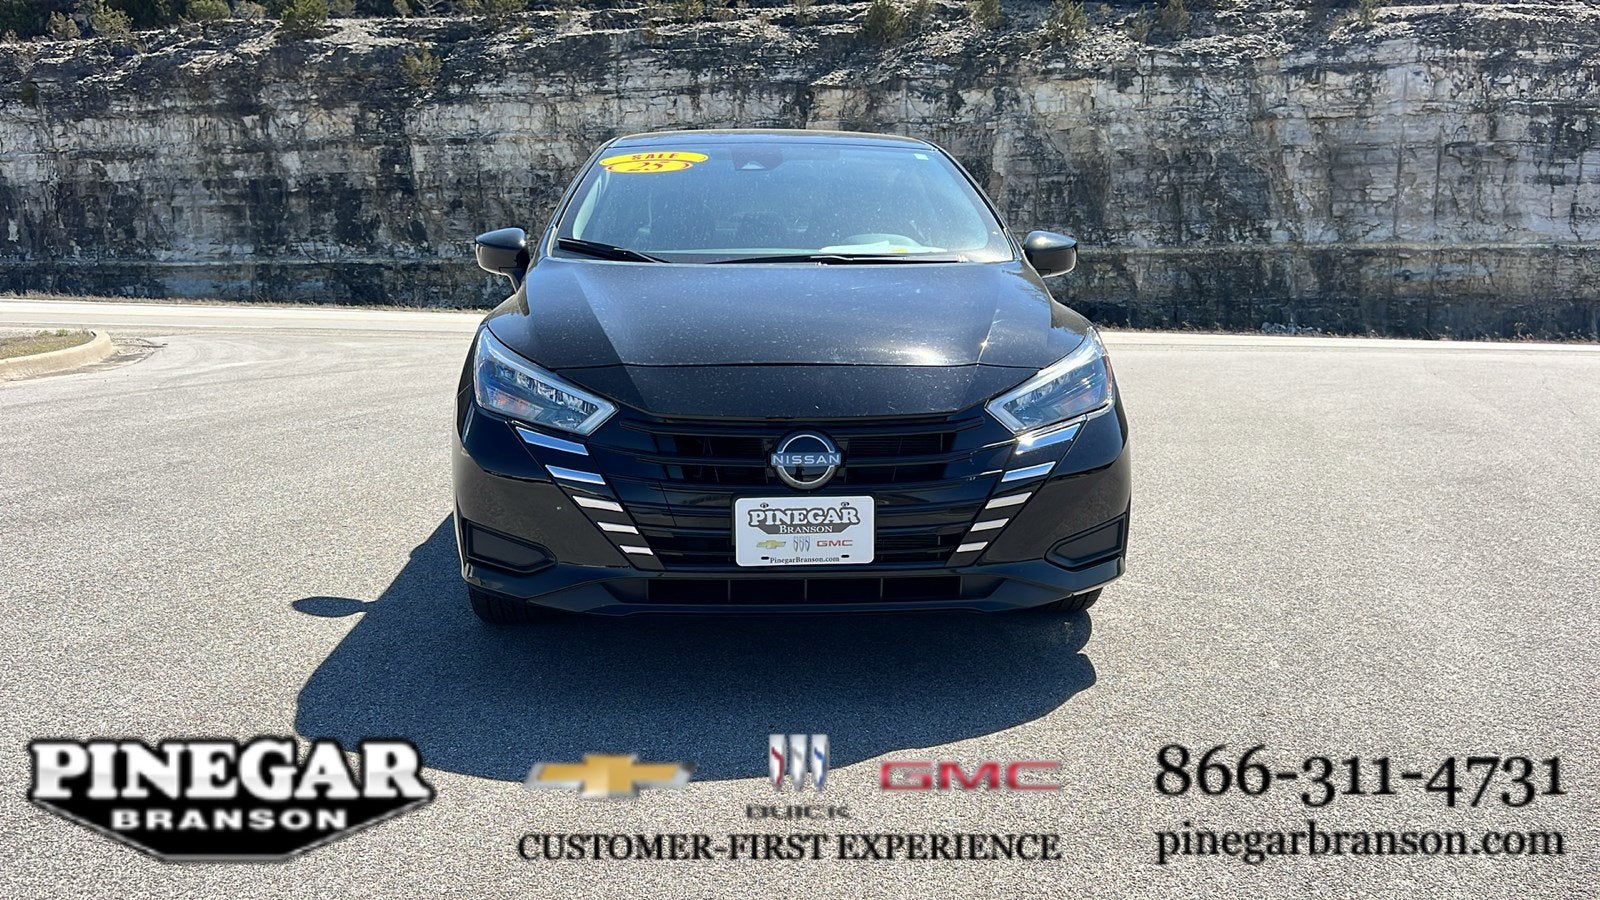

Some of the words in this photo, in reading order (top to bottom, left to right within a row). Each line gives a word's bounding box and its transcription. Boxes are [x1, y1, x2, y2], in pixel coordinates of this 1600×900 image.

[772, 454, 840, 465] NISSAN
[749, 509, 859, 526] PINEGAR
[816, 539, 853, 547] GMC
[769, 556, 840, 564] PinegarBranson.com
